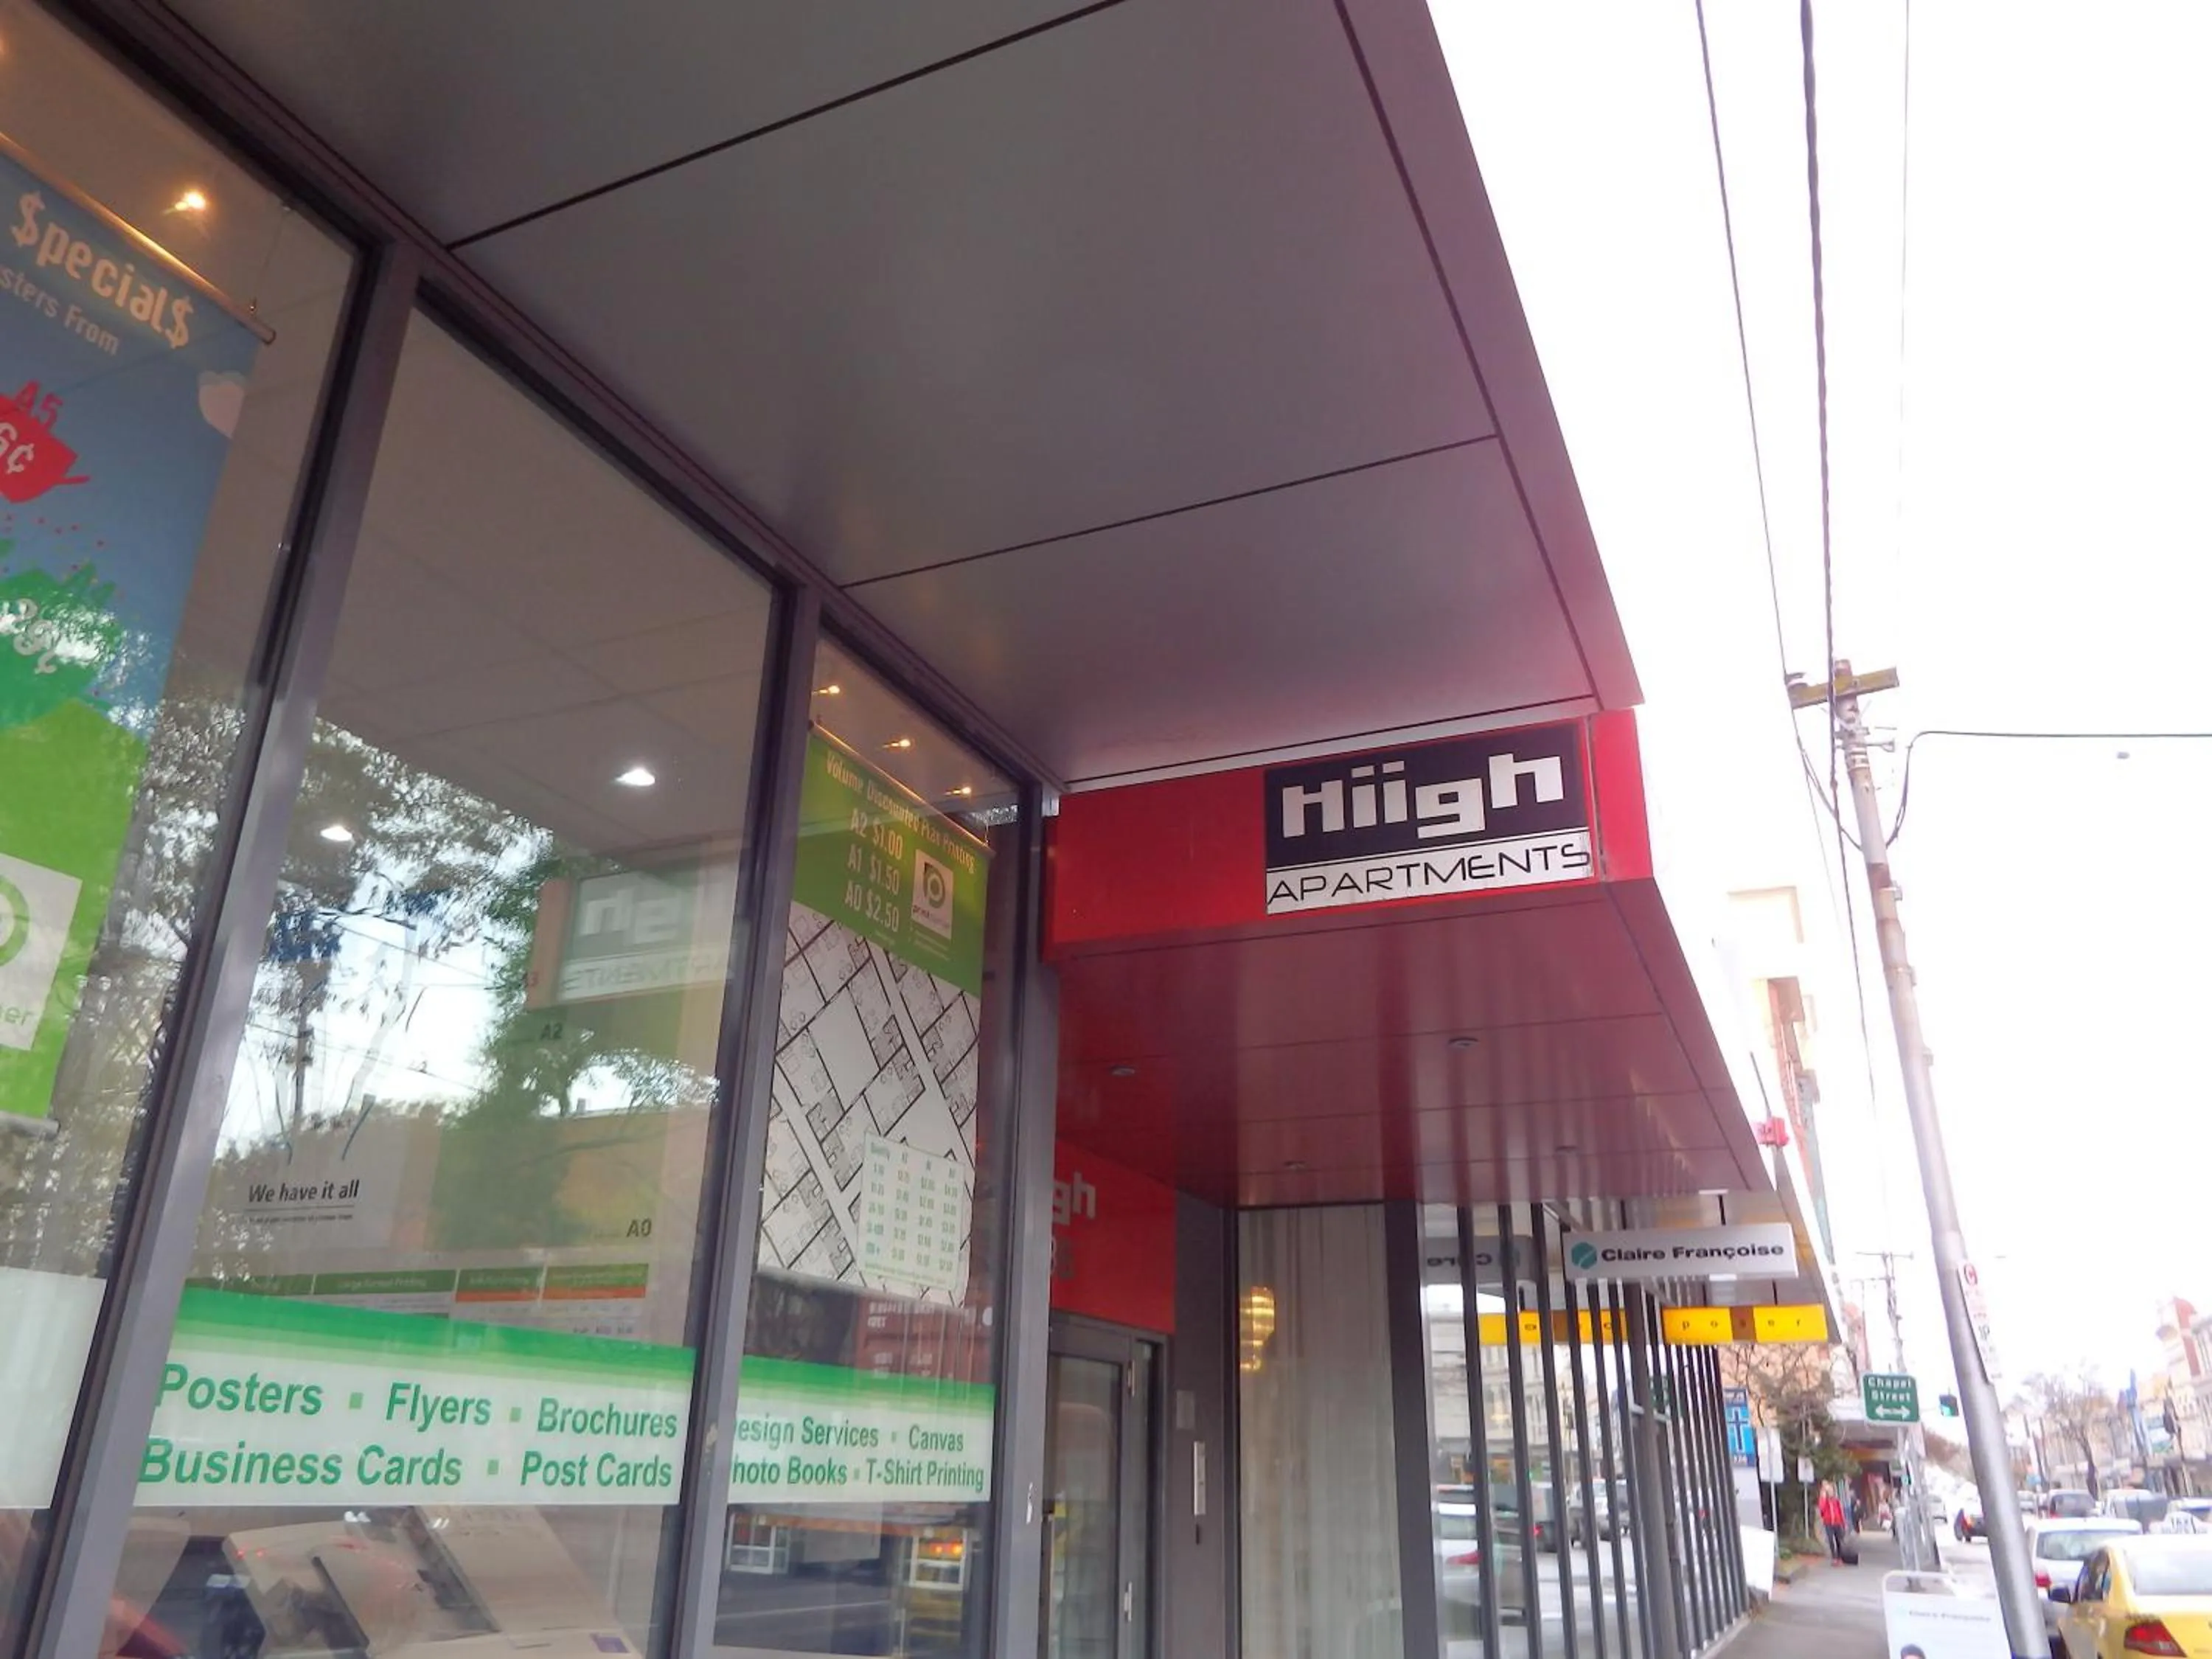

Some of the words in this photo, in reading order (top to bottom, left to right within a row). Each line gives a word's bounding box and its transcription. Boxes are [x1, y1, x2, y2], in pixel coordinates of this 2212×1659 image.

[64, 304, 119, 355] From
[1282, 752, 1564, 839] Hiigh
[850, 808, 868, 838] A2
[872, 817, 903, 860] $1.00
[847, 843, 862, 873] A1
[869, 852, 900, 896] $1.50
[1267, 843, 1591, 905] APARTMENTS
[866, 888, 900, 933] $2.50
[248, 1183, 274, 1203] We
[279, 1183, 318, 1203] have
[321, 1180, 335, 1199] it
[338, 1179, 360, 1199] all
[1601, 1248, 1666, 1262] Claire
[1672, 1243, 1784, 1260] Françoise
[154, 1363, 323, 1416] Posters
[386, 1382, 492, 1433] Flyers
[538, 1397, 678, 1439] Brochures
[1871, 1390, 1910, 1402] Street
[734, 1413, 794, 1451] esign
[801, 1415, 880, 1447] Services
[908, 1424, 964, 1452] Canvas
[138, 1437, 342, 1486] Business
[357, 1444, 462, 1486] Cards
[521, 1450, 588, 1487] Post
[596, 1452, 672, 1488] Cards
[787, 1455, 848, 1486] Books
[866, 1458, 922, 1486] T-Shirt
[926, 1460, 984, 1494] Printing
